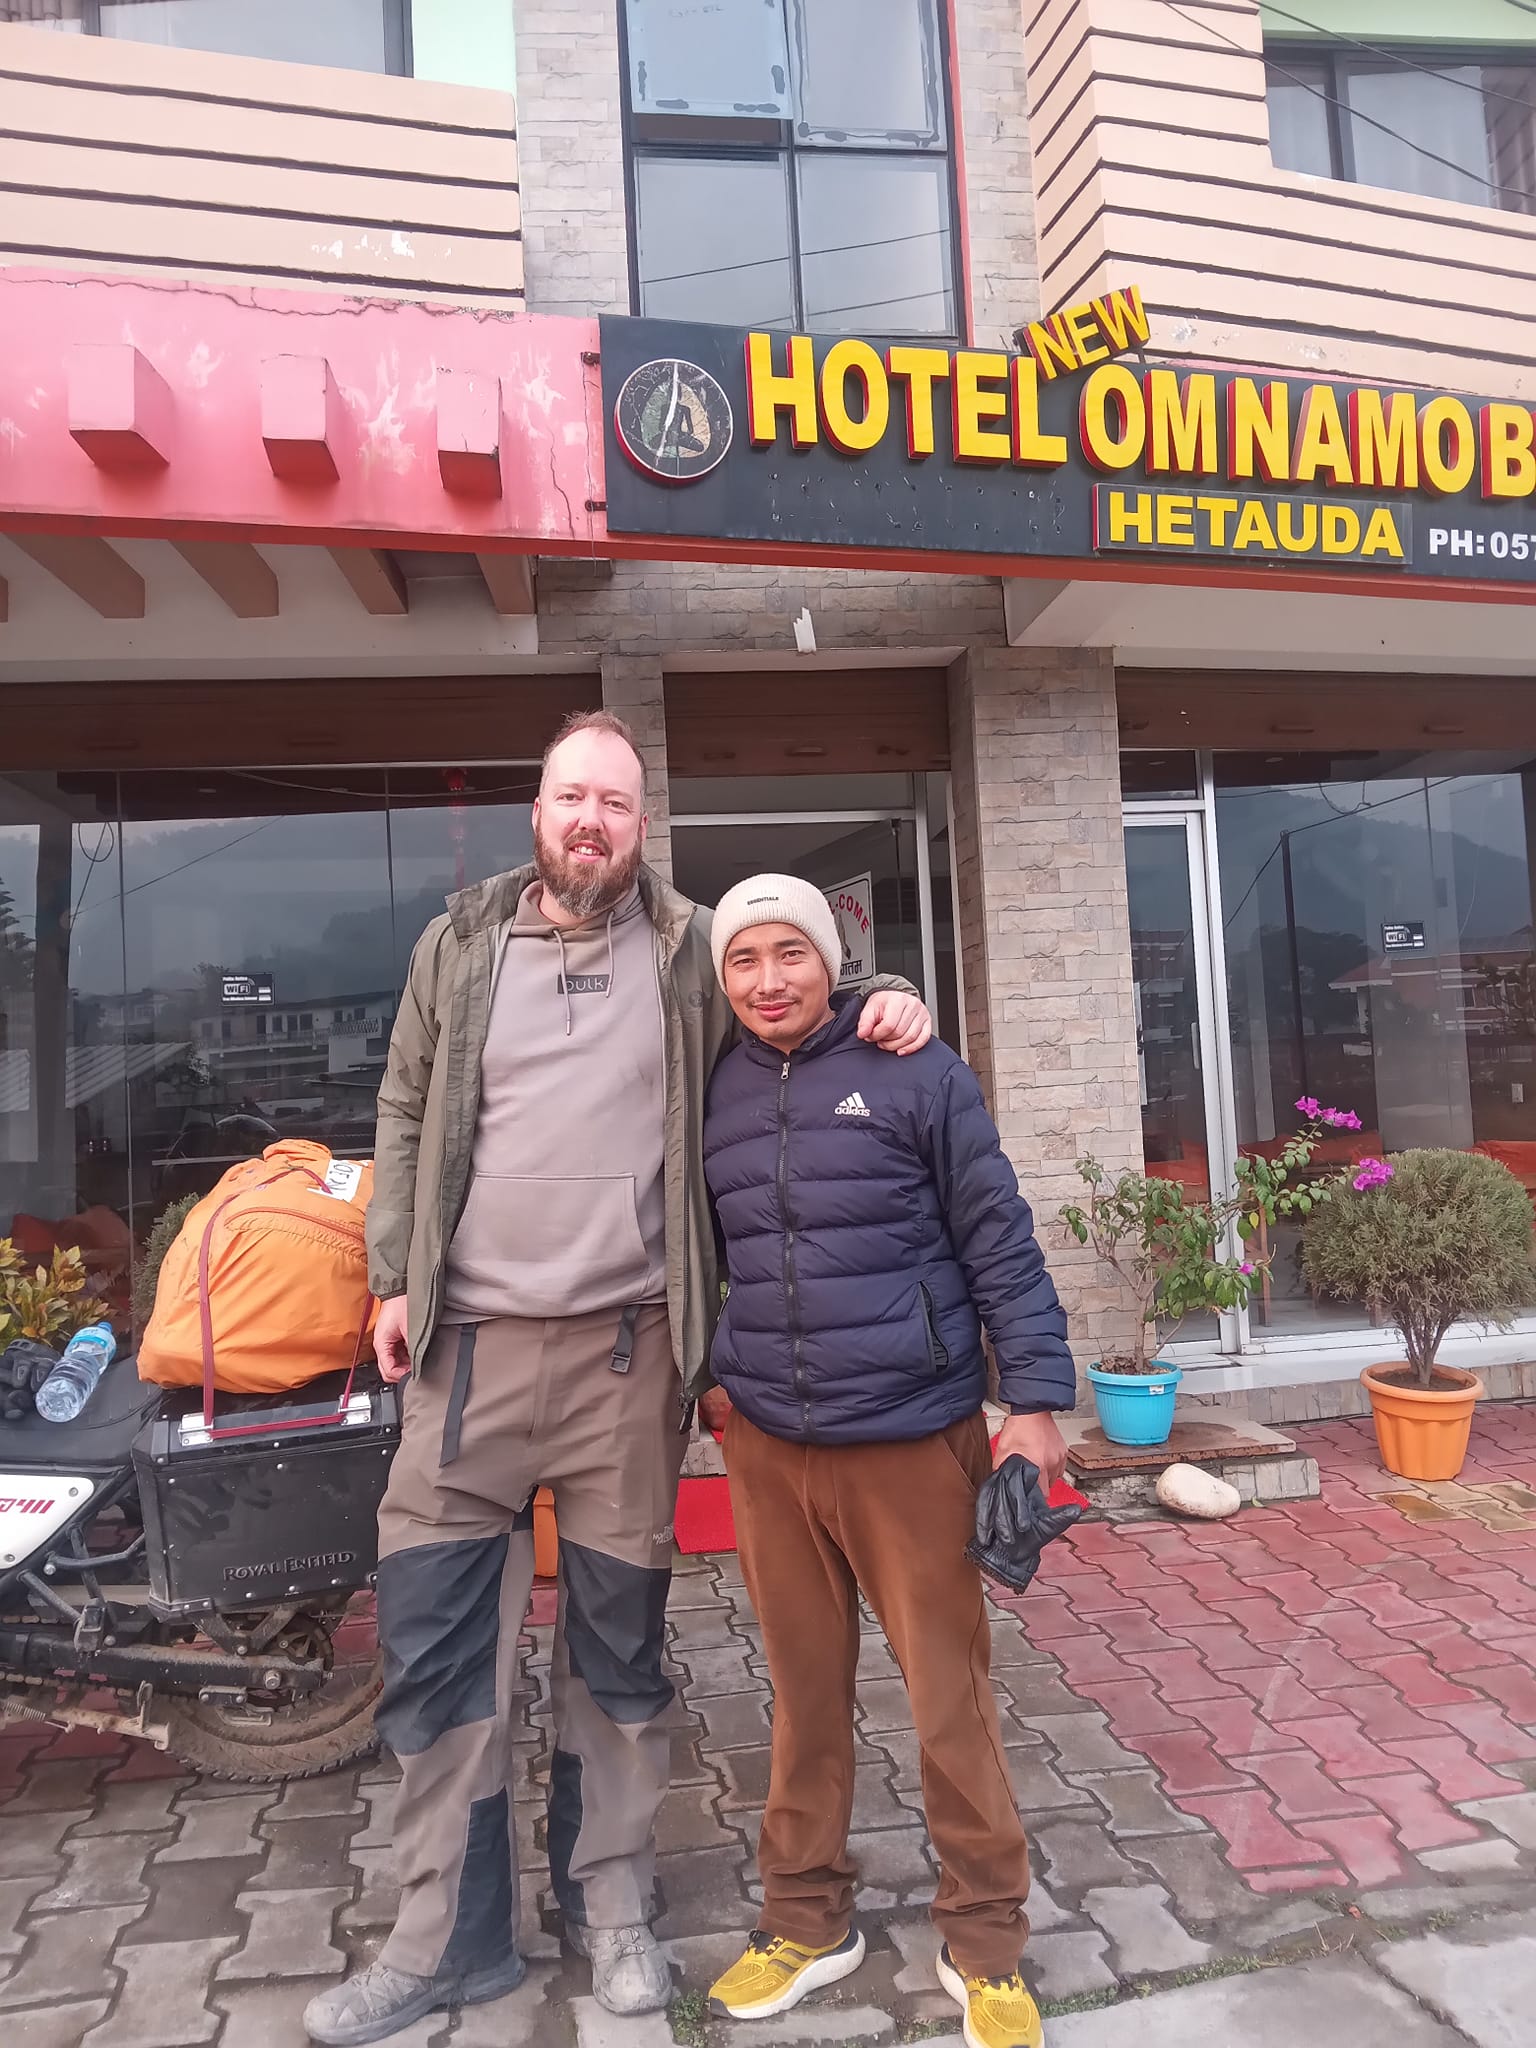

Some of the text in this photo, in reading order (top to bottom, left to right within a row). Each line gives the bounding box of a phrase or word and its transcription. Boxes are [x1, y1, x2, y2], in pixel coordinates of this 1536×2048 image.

[1023, 285, 1150, 381] NEW
[745, 332, 1536, 498] HOTEL OM NAMO B
[1109, 491, 1404, 557] HETAUDA
[840, 960, 863, 977] गतम
[834, 1106, 870, 1117] adidas
[223, 1551, 357, 1581] ROYAL ENFIELD
